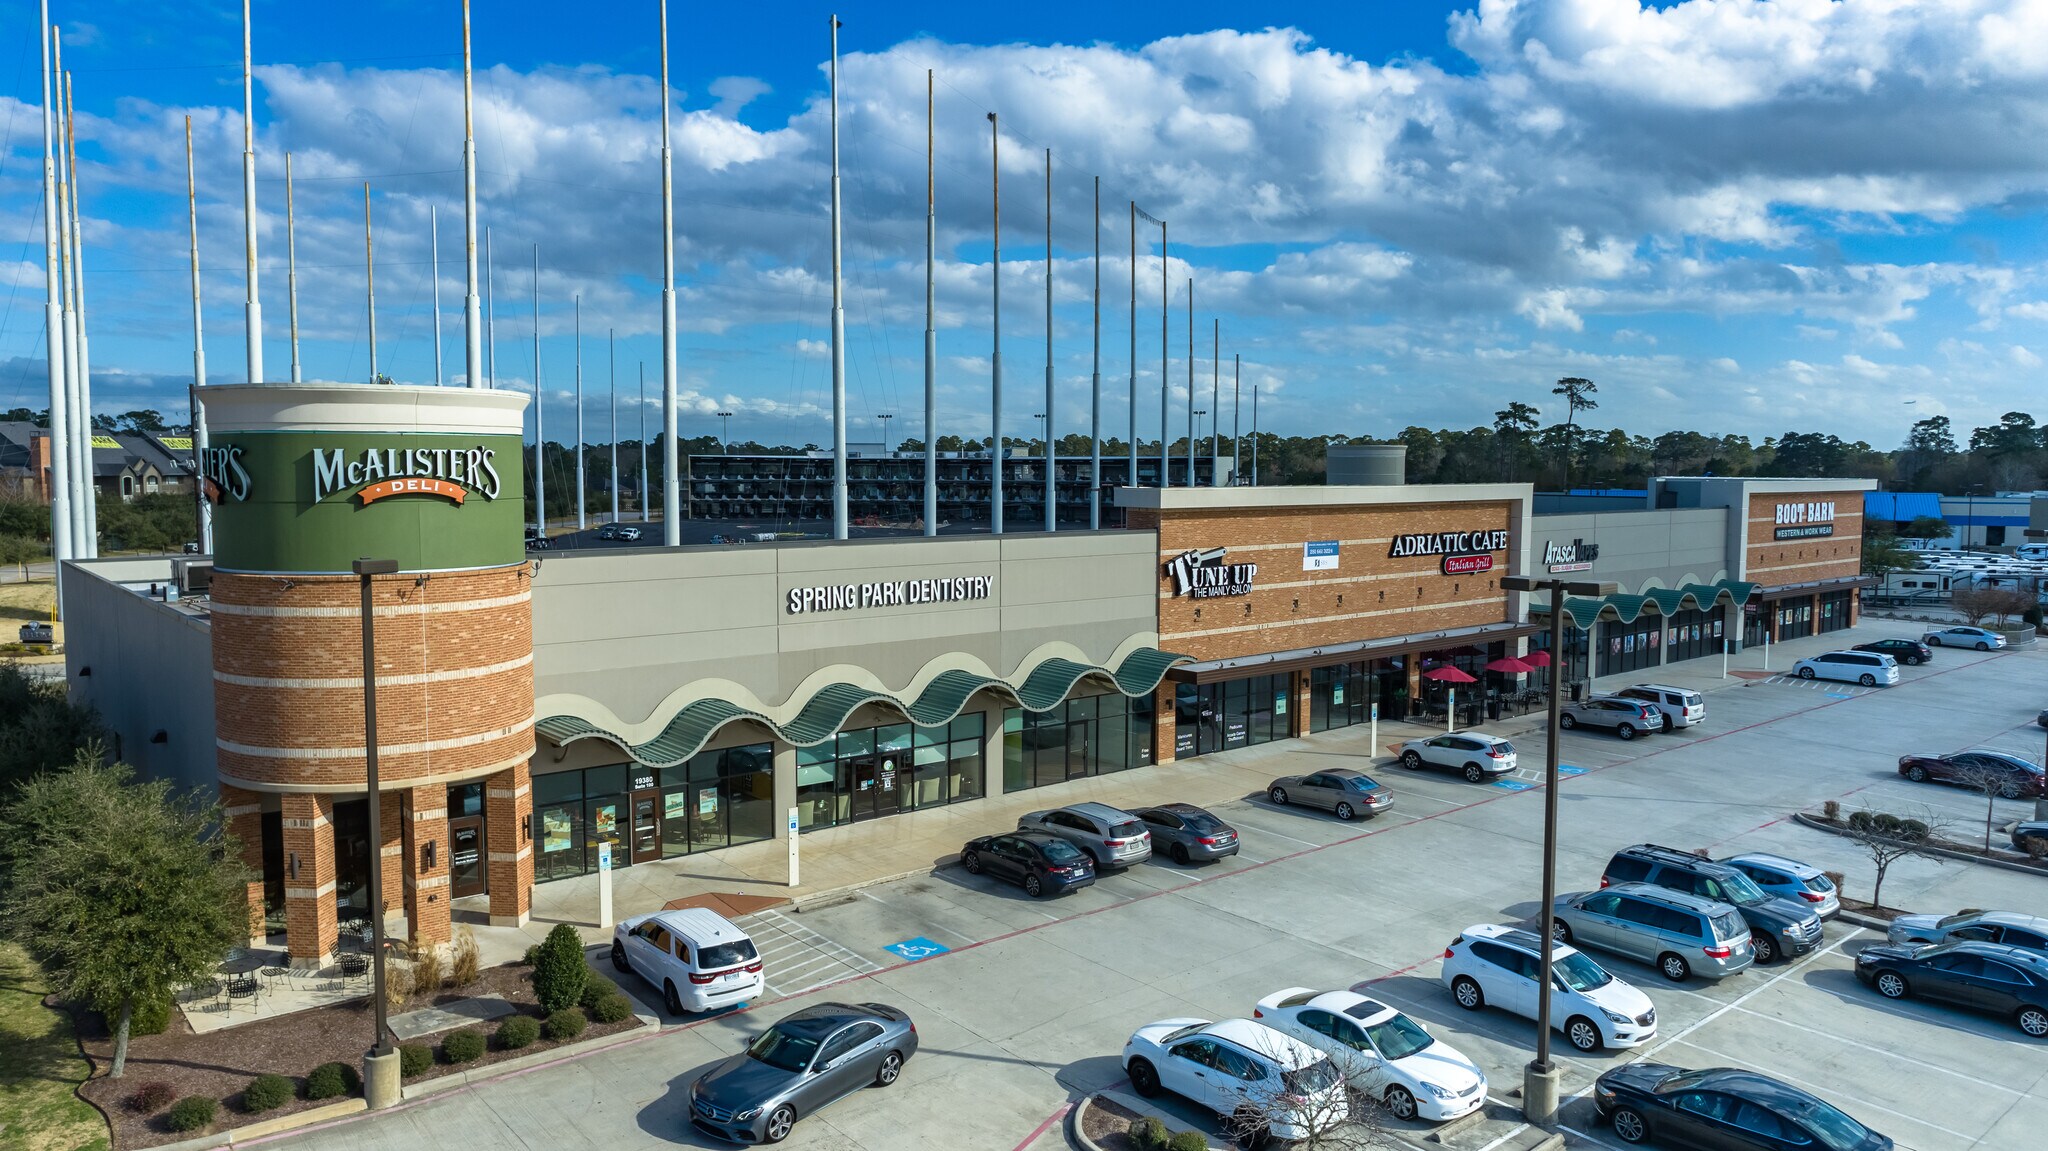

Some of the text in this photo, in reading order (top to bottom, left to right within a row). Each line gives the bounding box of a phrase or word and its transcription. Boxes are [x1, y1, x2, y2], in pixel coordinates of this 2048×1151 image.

[313, 446, 500, 503] McALISTER'S
[391, 480, 439, 491] DELI
[1776, 502, 1834, 524] BOOT BARN
[1776, 526, 1832, 538] WESTERN & WORK WEAR
[1393, 531, 1507, 556] ADRIATIC CAFE
[1448, 556, 1490, 572] Italian Grill
[1168, 554, 1258, 595] TUNE UP
[790, 576, 994, 613] SPRING PARK DENTISTRY
[1194, 584, 1253, 597] THE MANLY SALON
[635, 776, 653, 784] 19380
